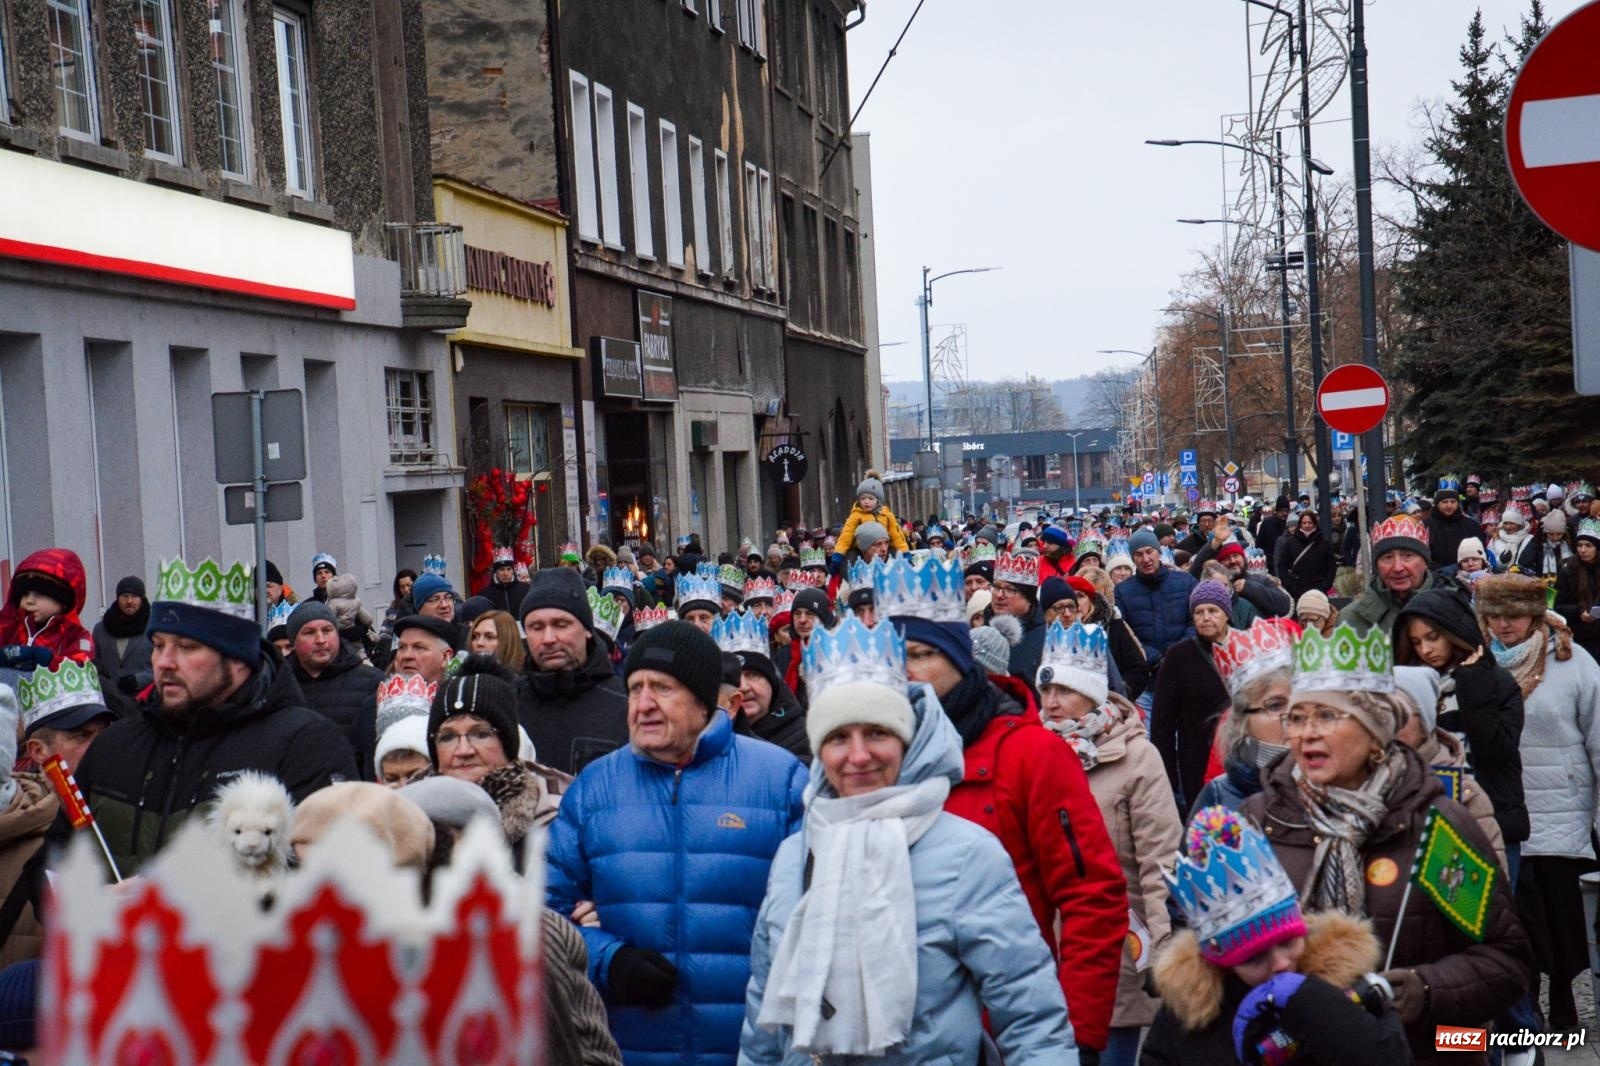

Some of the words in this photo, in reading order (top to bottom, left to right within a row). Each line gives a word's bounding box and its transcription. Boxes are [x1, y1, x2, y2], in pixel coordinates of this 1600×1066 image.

[464, 243, 549, 305] KWIACIARNIA
[1336, 431, 1349, 448] P
[1183, 451, 1193, 464] P
